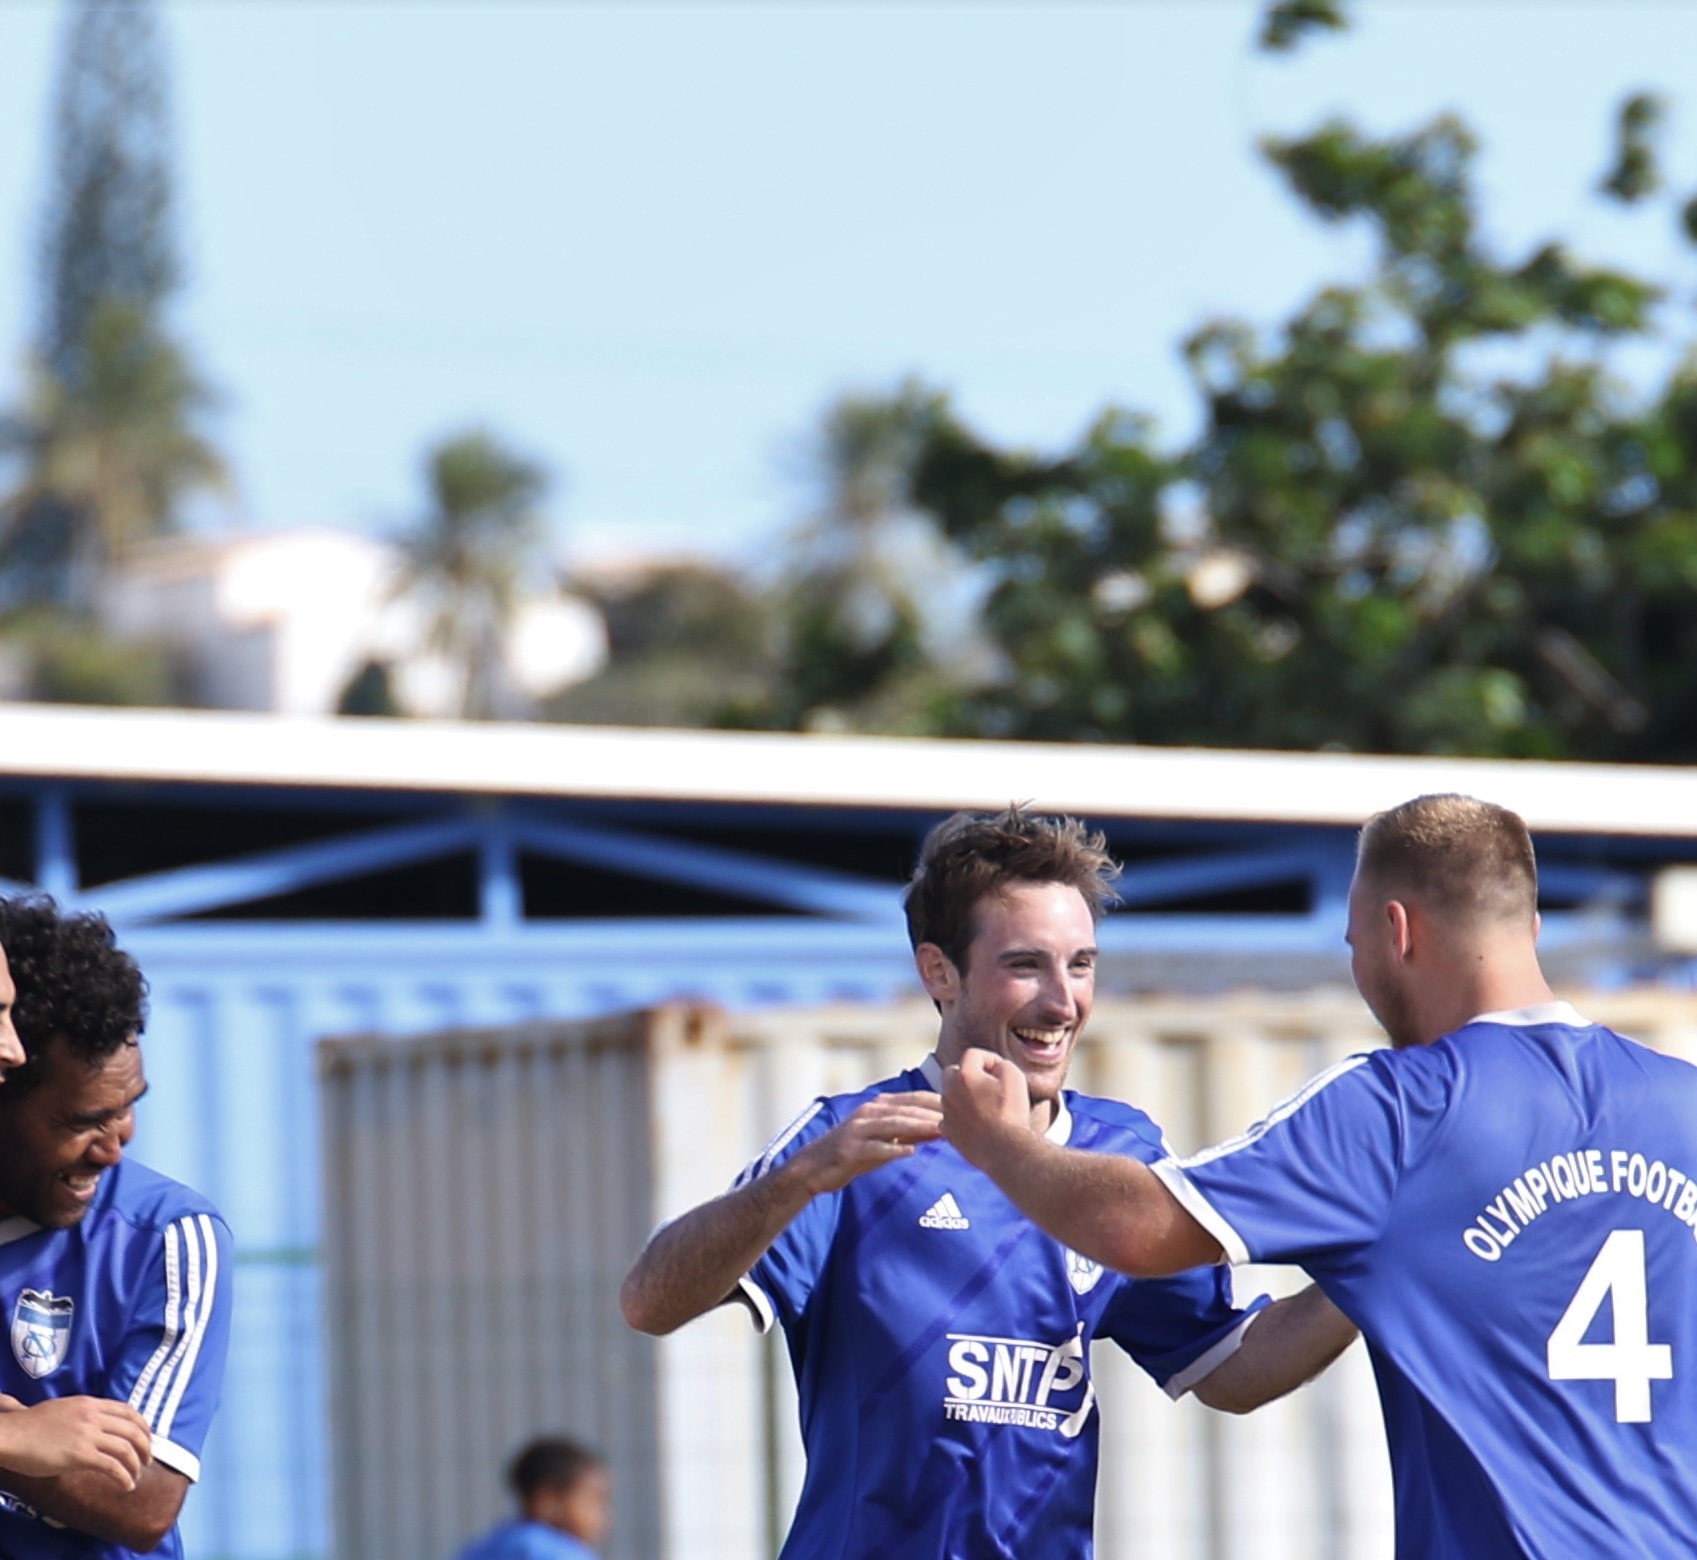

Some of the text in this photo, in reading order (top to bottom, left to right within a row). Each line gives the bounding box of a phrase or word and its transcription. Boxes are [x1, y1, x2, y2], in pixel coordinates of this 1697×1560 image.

[918, 1216, 969, 1230] adidas
[1462, 1150, 1608, 1262] OLYMPIQUE
[1546, 1229, 1673, 1423] 4
[946, 1340, 1084, 1407] SNTP
